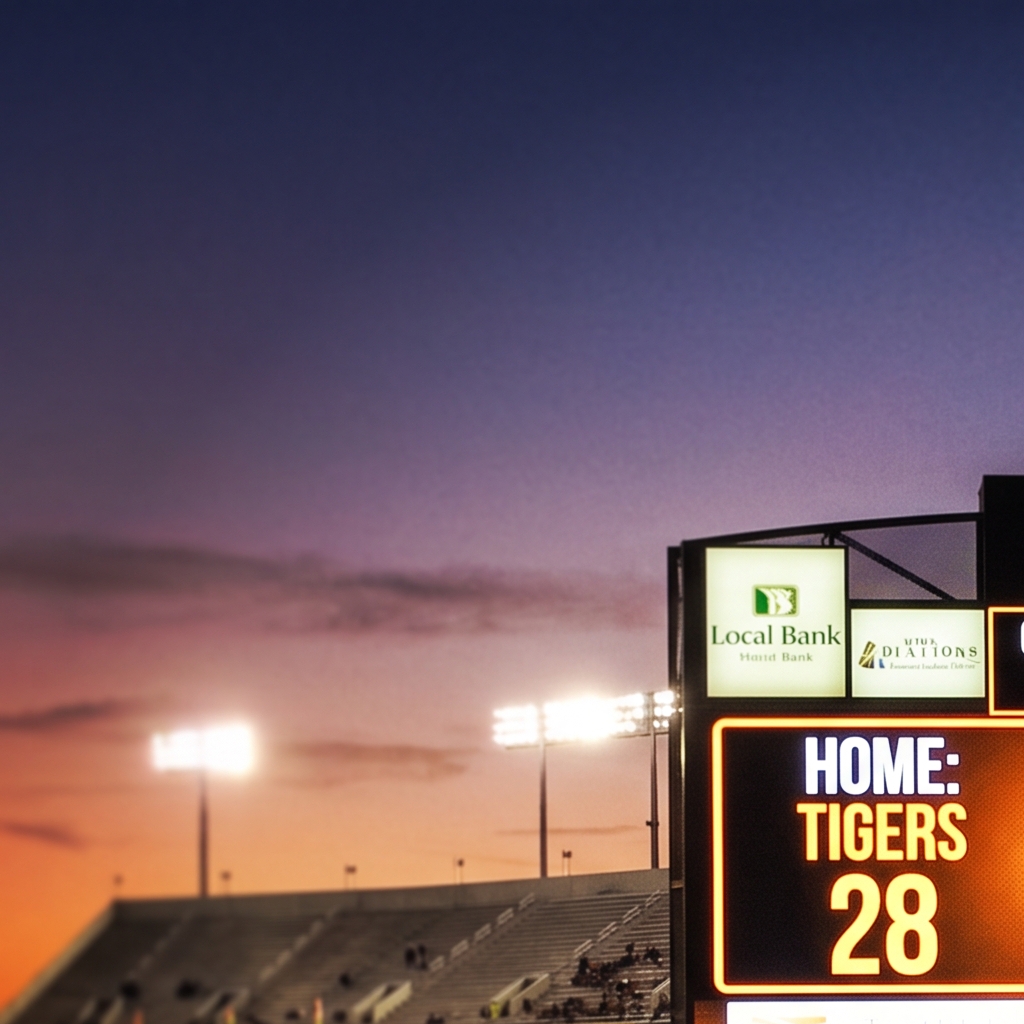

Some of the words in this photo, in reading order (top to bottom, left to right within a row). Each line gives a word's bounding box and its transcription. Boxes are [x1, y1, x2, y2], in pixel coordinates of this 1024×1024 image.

[711, 624, 773, 645] Local
[781, 624, 842, 645] Bank
[804, 736, 961, 795] HOME:
[796, 803, 968, 862] TIGERS
[830, 873, 939, 976] 28
